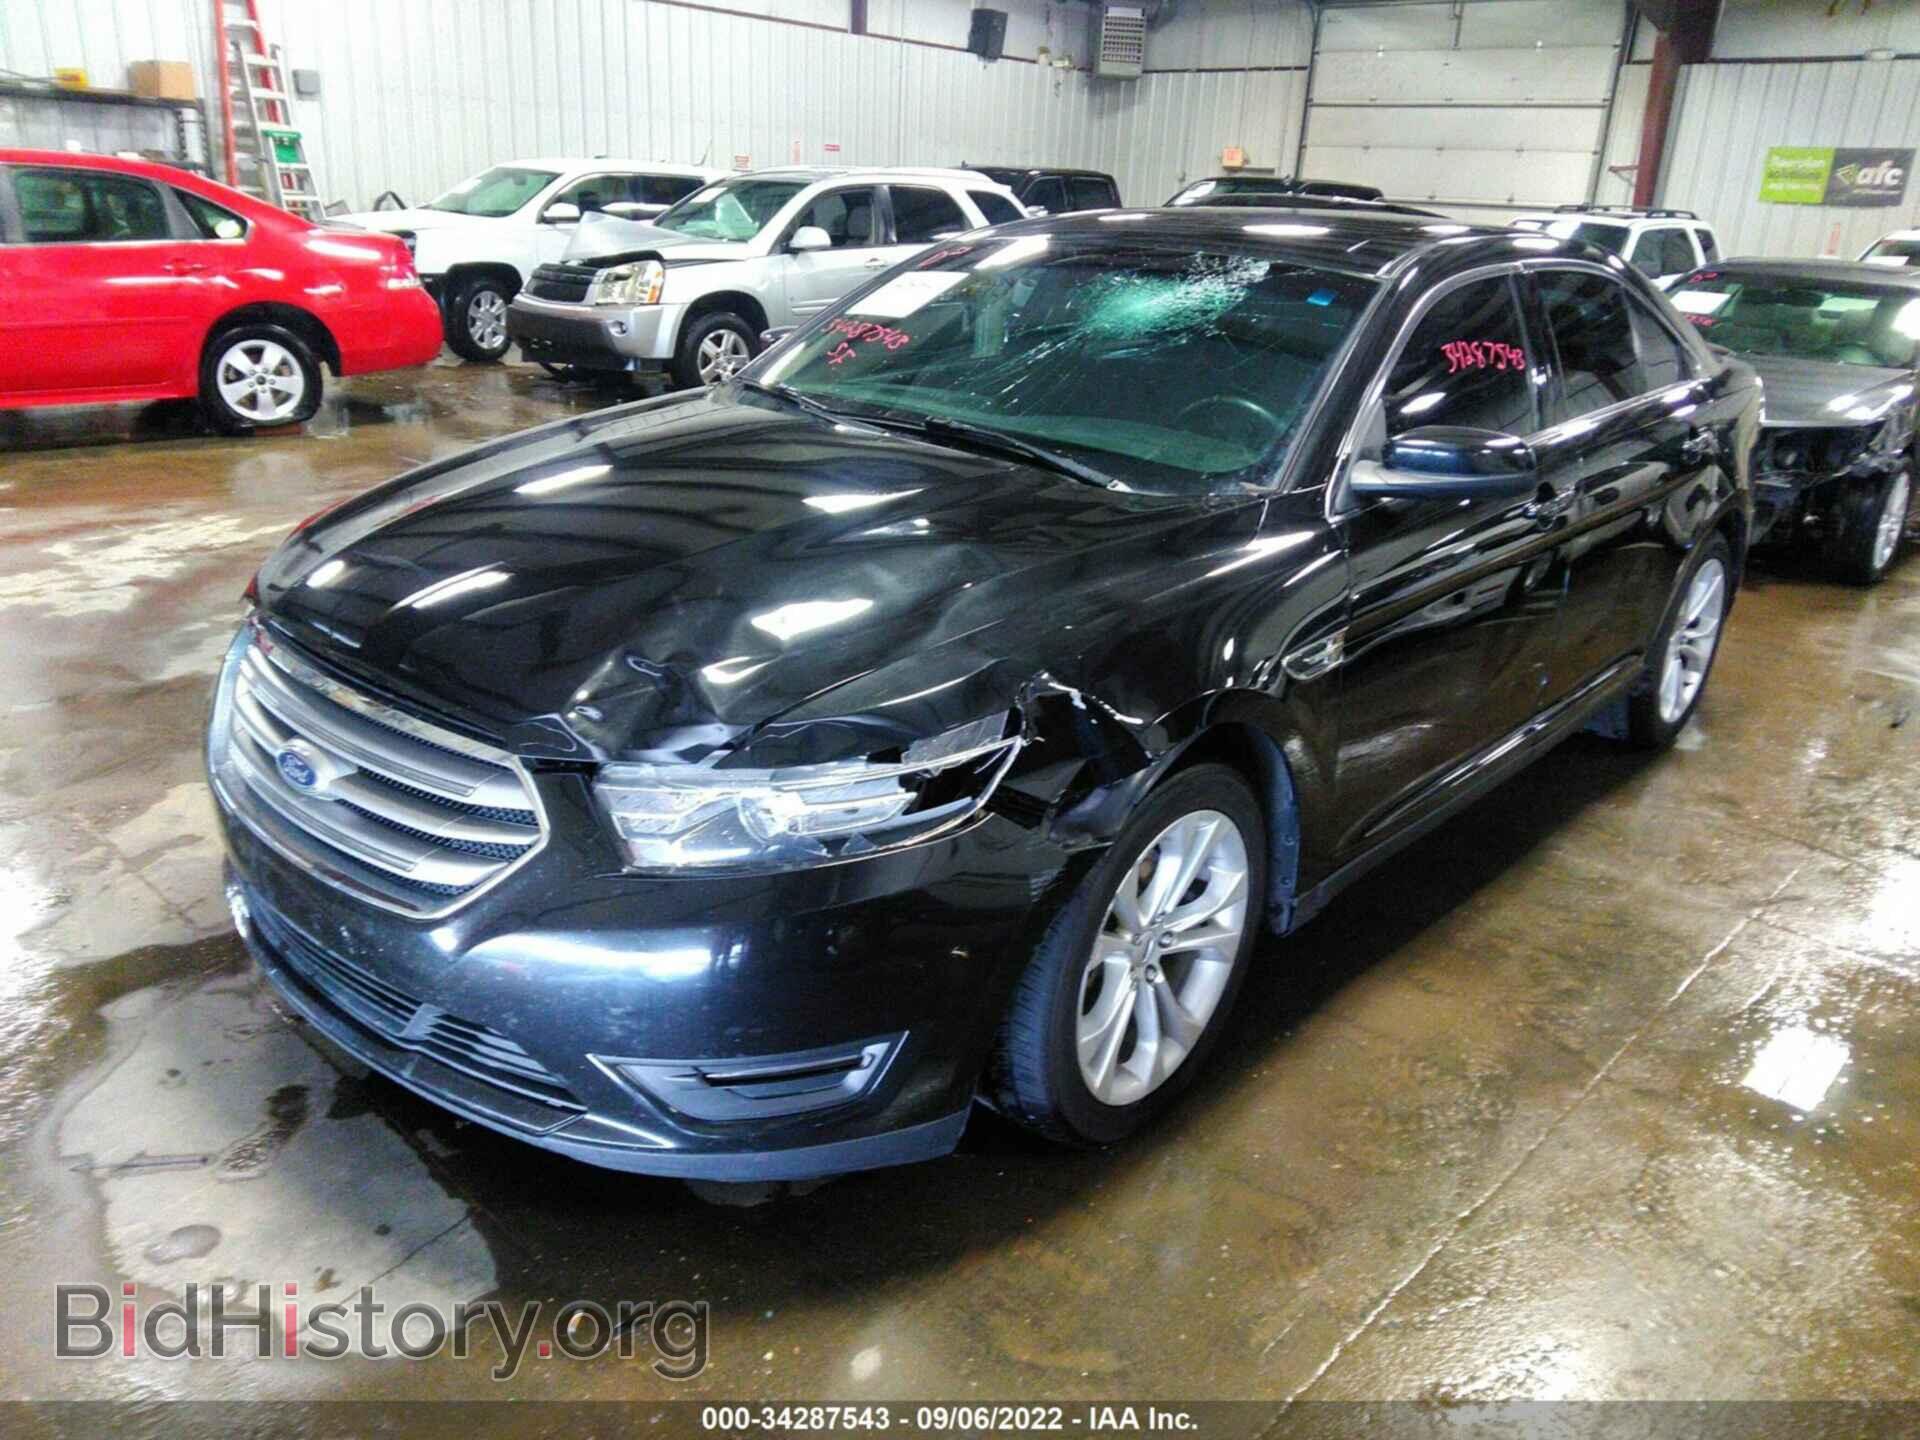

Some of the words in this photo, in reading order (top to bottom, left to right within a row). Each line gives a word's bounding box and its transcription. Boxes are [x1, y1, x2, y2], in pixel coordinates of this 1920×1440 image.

[1856, 160, 1904, 185] afc
[1440, 340, 1526, 373] 34287543
[282, 753, 311, 783] Ford
